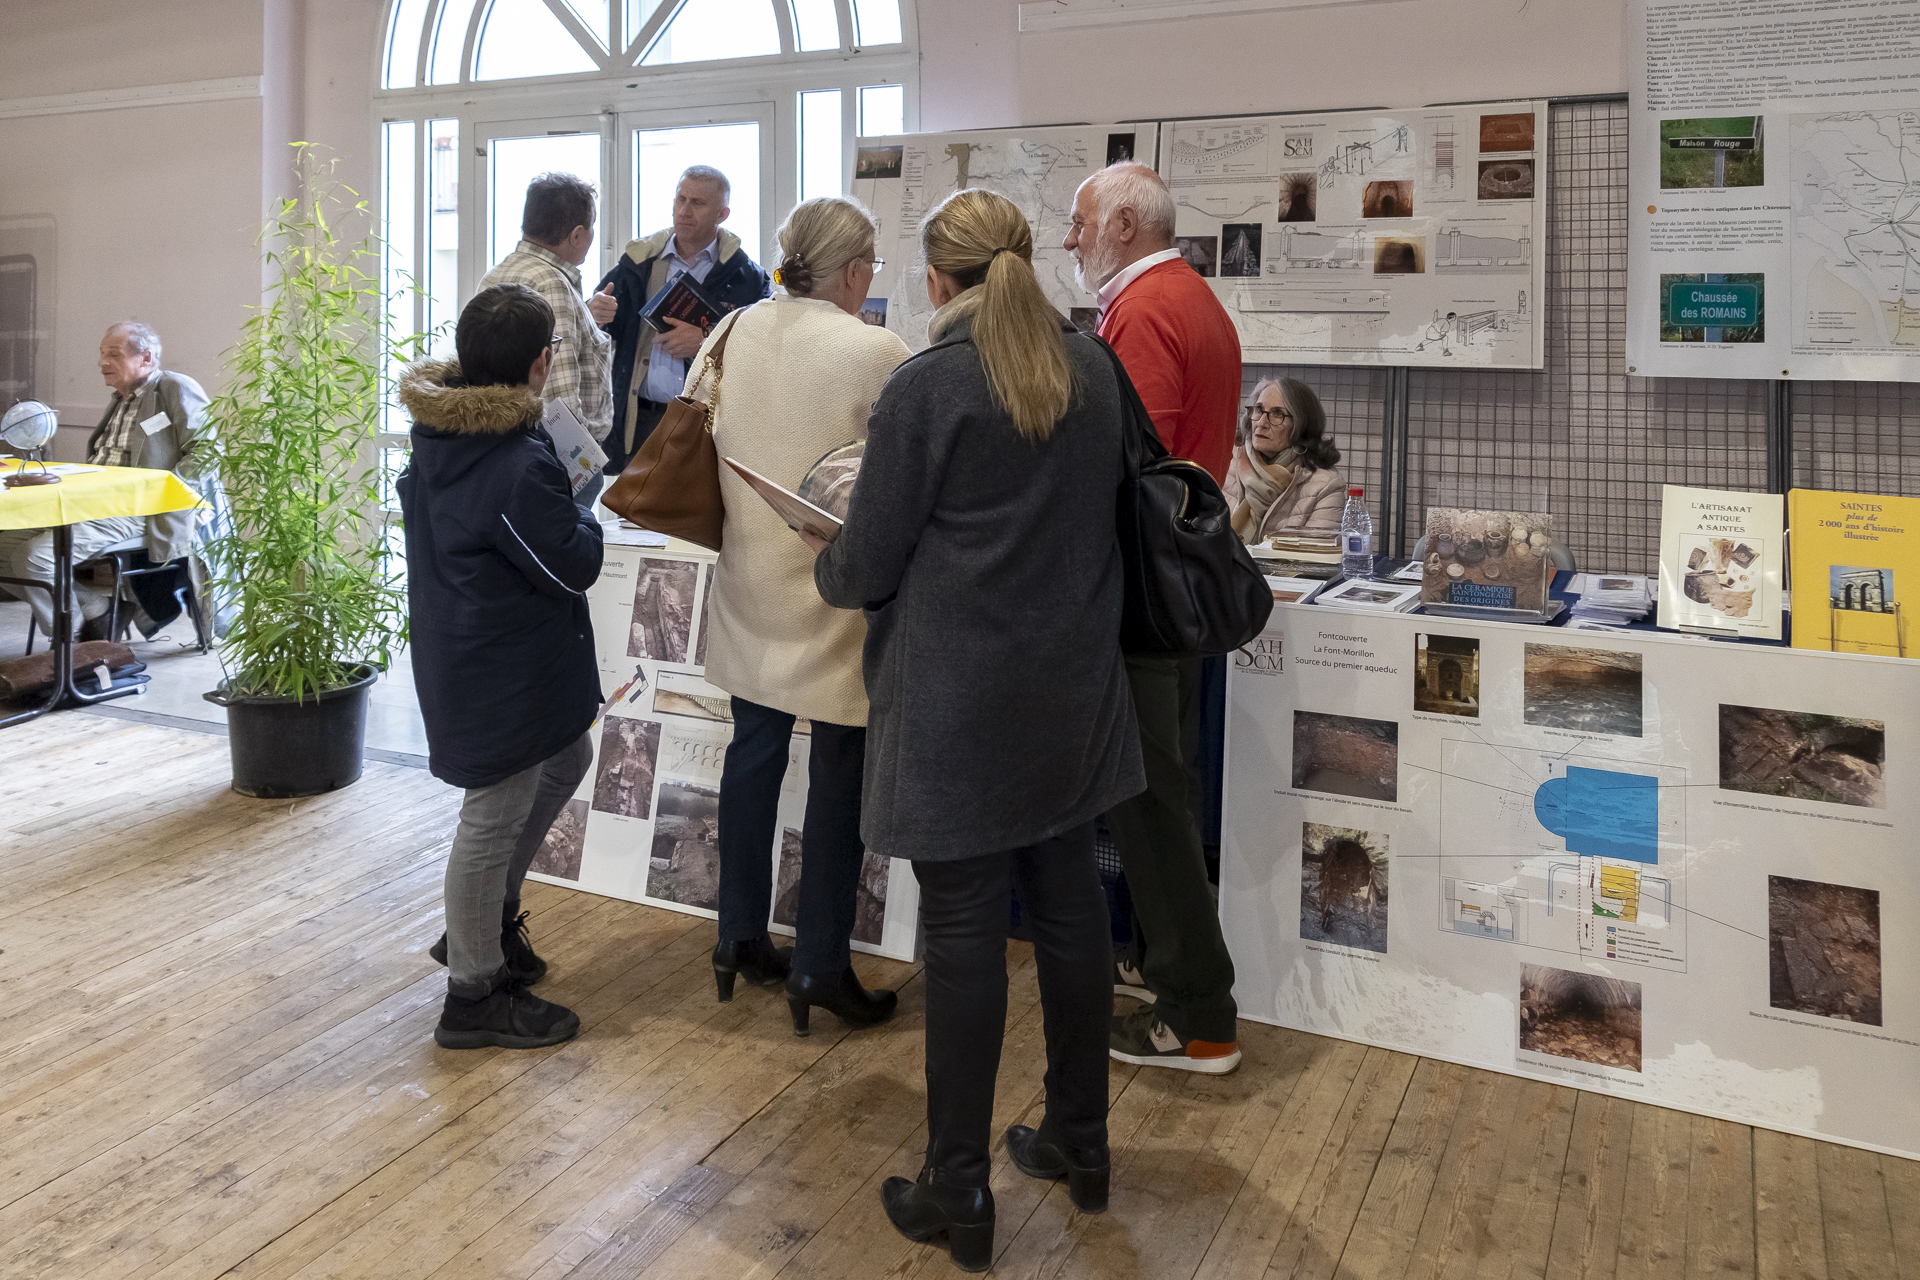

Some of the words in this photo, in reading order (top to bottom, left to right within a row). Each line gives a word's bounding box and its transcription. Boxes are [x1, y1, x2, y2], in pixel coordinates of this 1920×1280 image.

[1714, 140, 1740, 148] Rouge
[1691, 291, 1738, 303] Chaussée
[1681, 307, 1698, 318] des
[1701, 307, 1746, 318] ROMAINS
[547, 412, 560, 426] Inrap
[1691, 502, 1752, 513] L'ARTISANAT
[1840, 502, 1882, 512] SAINTES
[1702, 514, 1741, 522] ANTIQUE
[1845, 513, 1864, 521] plus
[1706, 525, 1746, 533] SAINTES
[1863, 523, 1905, 533] d'histoire
[1844, 532, 1879, 541] illustrée
[1452, 590, 1513, 599] SAINTONGEAISE
[1471, 597, 1510, 605] ORIGINES
[1318, 632, 1368, 643] Fontcouverte
[1314, 645, 1322, 653] La
[1324, 646, 1374, 658] Font-Morillon
[1295, 657, 1320, 666] Source
[1321, 658, 1332, 667] du
[1334, 661, 1362, 671] premier
[1364, 664, 1398, 674] aqueduc
[1428, 717, 1448, 725] nymphée,
[1569, 733, 1586, 741] captage
[1723, 800, 1750, 809] d'ensemble
[1782, 808, 1802, 816] l'escalier
[1817, 812, 1834, 820] départ
[1306, 944, 1319, 952] Départ
[1789, 1019, 1820, 1028] appartenant
[1870, 1033, 1892, 1042] l'escalier
